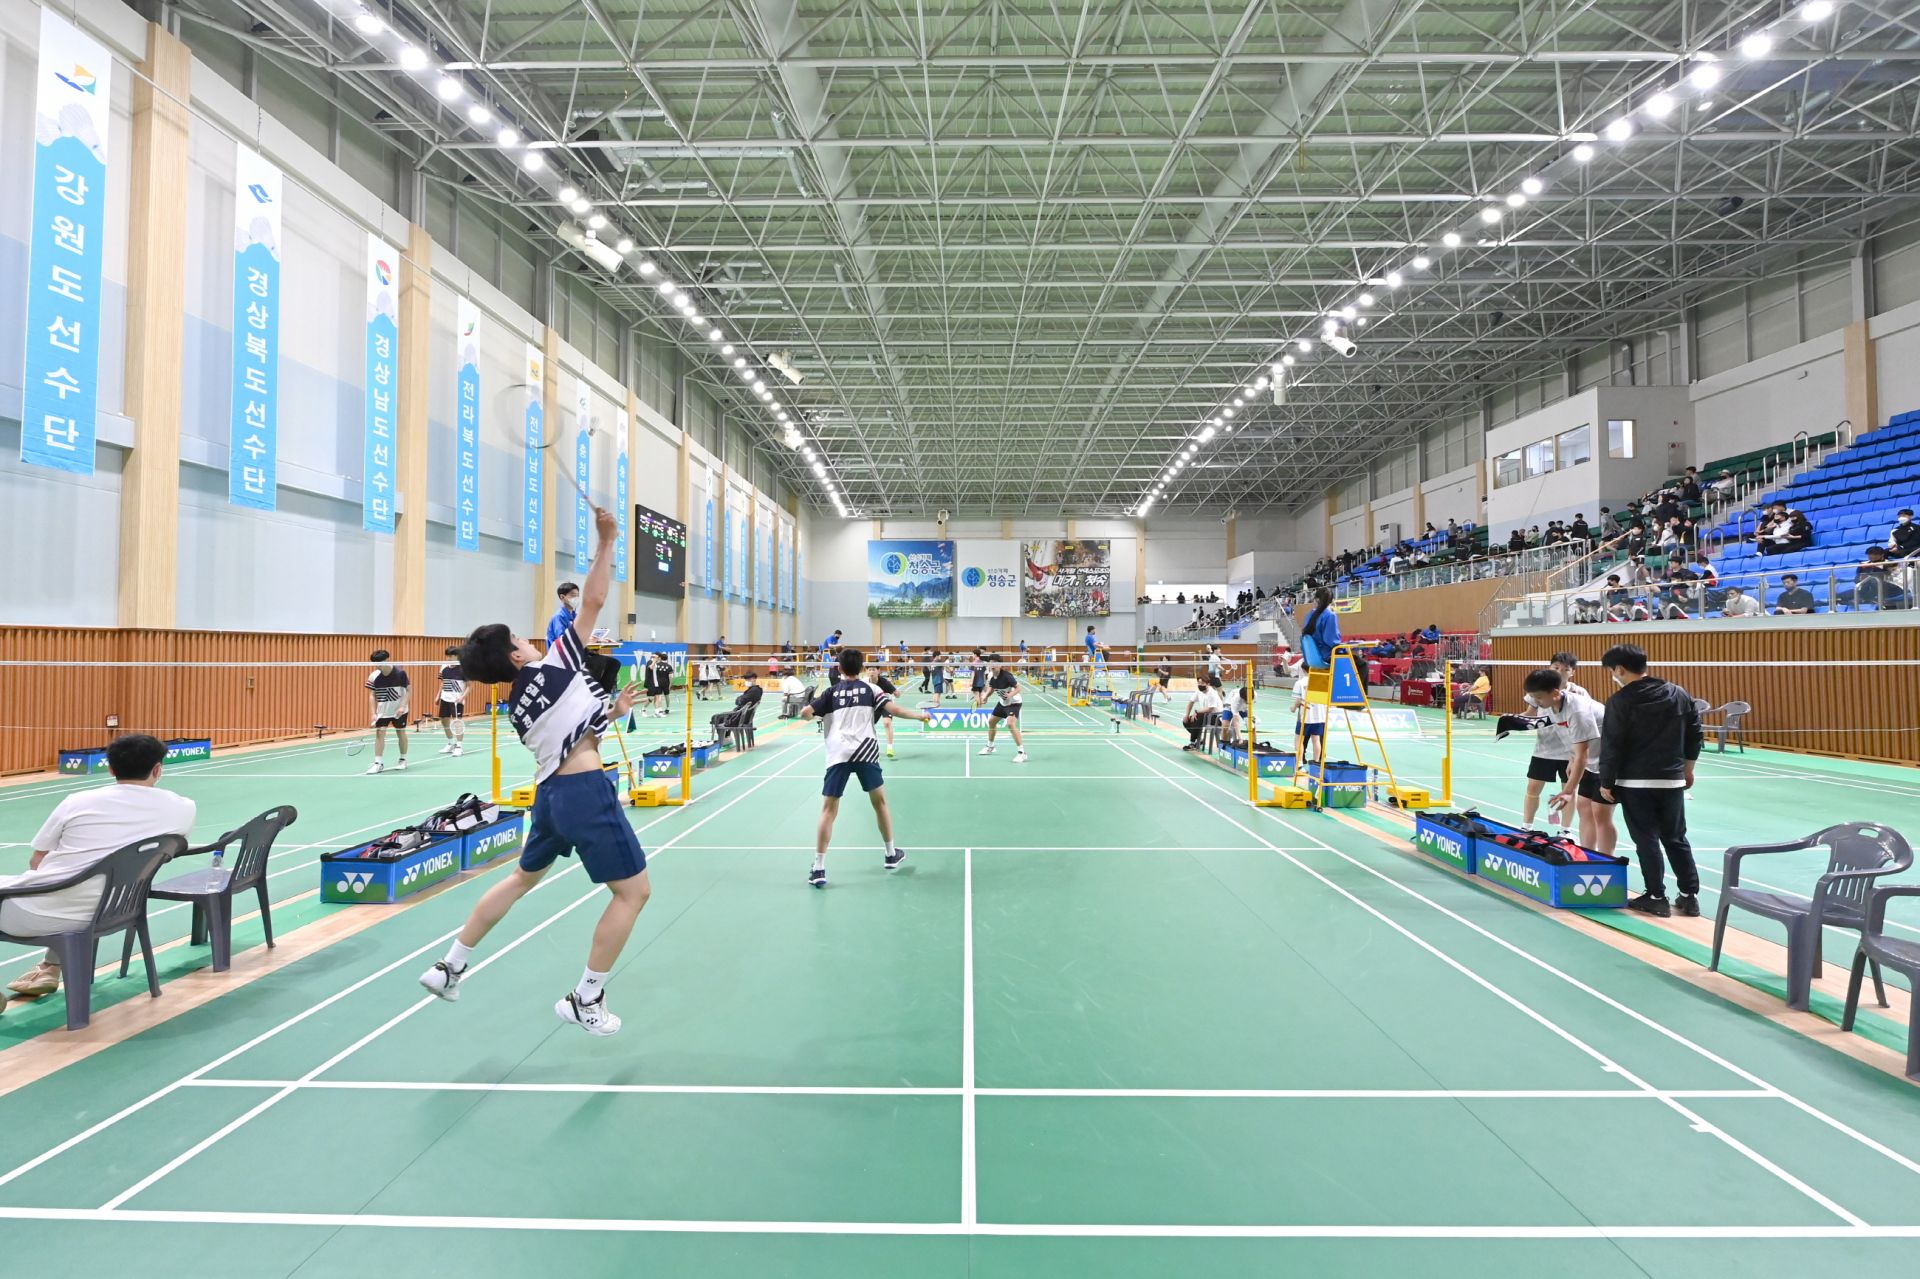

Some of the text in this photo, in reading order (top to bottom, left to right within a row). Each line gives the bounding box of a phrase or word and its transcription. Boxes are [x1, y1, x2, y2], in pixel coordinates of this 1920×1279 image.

[909, 561, 941, 575] 청송군
[987, 574, 1017, 588] 청송군
[1343, 673, 1351, 687] 1
[961, 713, 1009, 728] YON
[180, 746, 206, 757] YONEX
[492, 827, 517, 849] YONEX
[1436, 834, 1463, 860] YONEX
[422, 850, 453, 877] YONEX
[1504, 859, 1541, 889] YONEX
